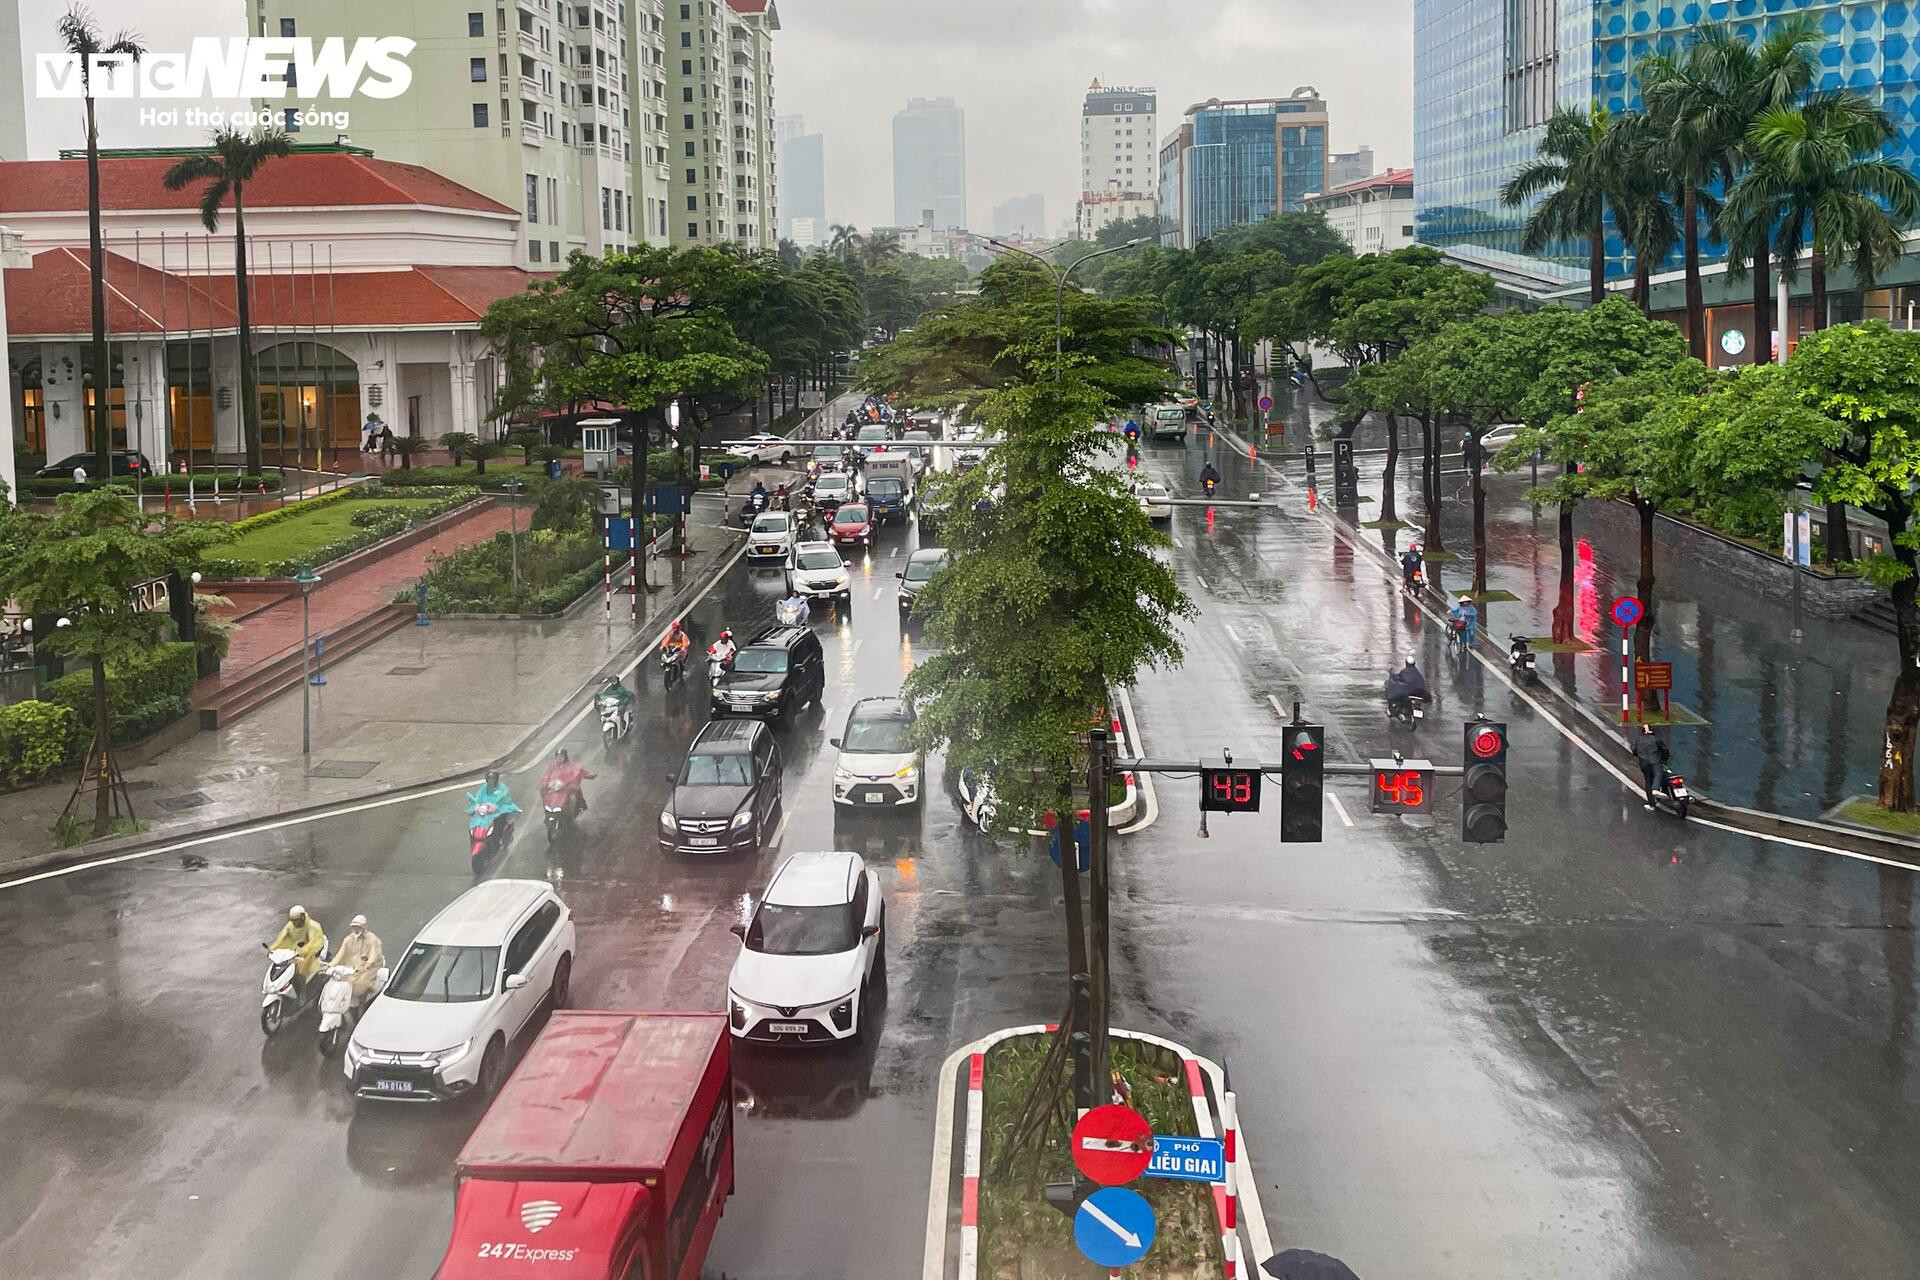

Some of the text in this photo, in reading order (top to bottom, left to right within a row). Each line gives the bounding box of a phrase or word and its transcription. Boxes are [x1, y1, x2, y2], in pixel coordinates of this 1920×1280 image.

[1213, 772, 1251, 803] 43
[1377, 769, 1423, 806] 45
[1174, 1141, 1200, 1152] PHỐ
[1148, 1150, 1217, 1175] LIỄU GIAI
